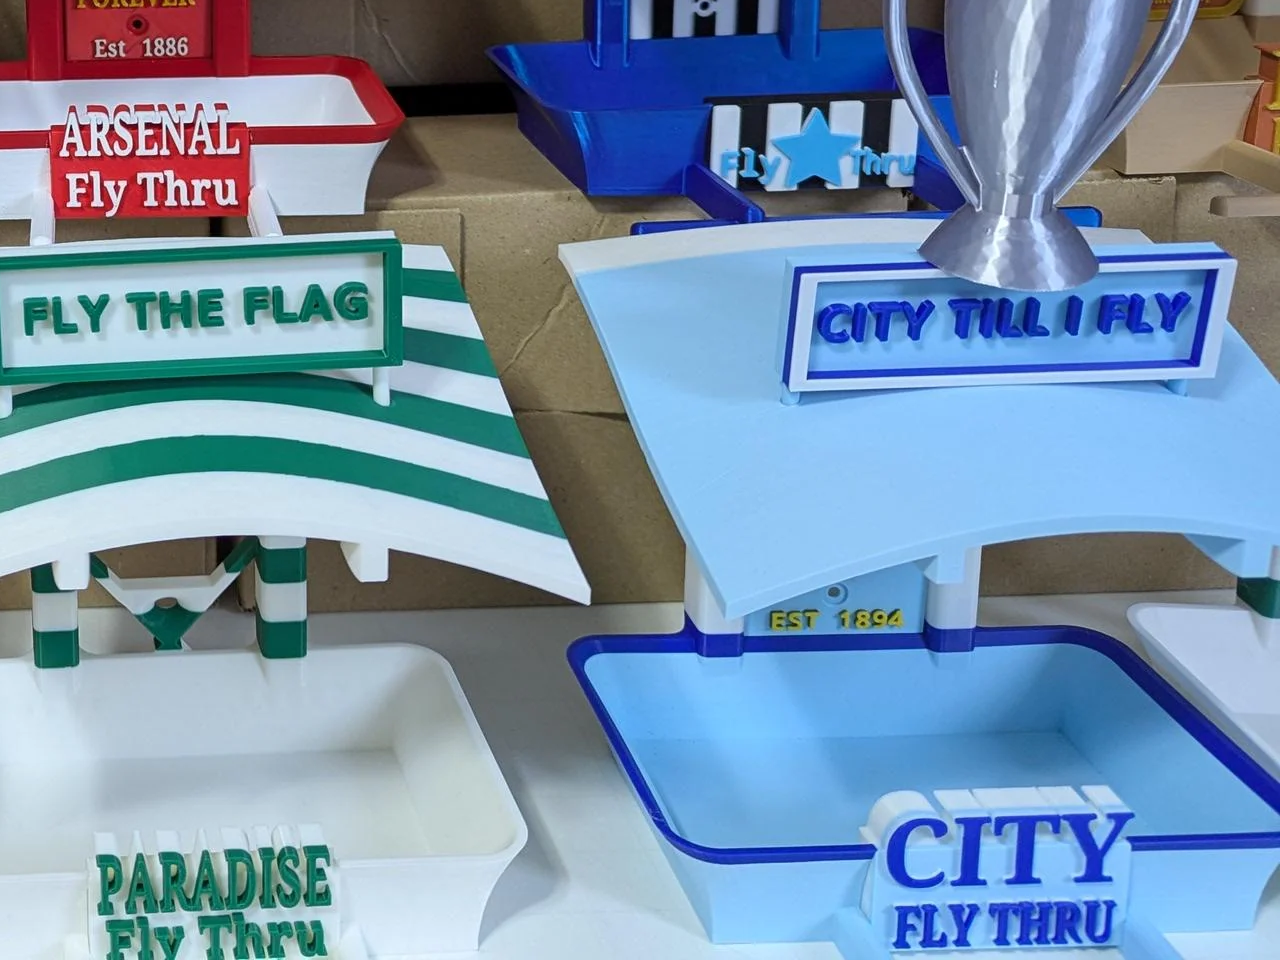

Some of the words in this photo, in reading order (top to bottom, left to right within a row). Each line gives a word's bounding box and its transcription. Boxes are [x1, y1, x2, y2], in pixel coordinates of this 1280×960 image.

[94, 39, 126, 58] Est
[142, 37, 189, 57] 1886
[59, 106, 240, 158] ARSENAL
[722, 147, 780, 185] Fly
[846, 147, 915, 177] Thru
[66, 171, 128, 218] Fly
[137, 170, 238, 208] Thru
[23, 294, 110, 336] FLY
[126, 288, 225, 331] THE
[243, 281, 369, 325] FLAG
[818, 300, 935, 343] CITY
[948, 297, 1050, 339] TILL
[1063, 295, 1084, 336] I
[1096, 291, 1192, 335] FLY
[771, 610, 820, 631] EST
[839, 609, 903, 630] 1894
[886, 810, 1136, 889] CITY
[96, 844, 332, 916] PARADISE
[105, 916, 185, 960] Fly
[197, 912, 328, 960] Thru
[892, 902, 980, 949] FLY
[988, 900, 1118, 947] THRU
